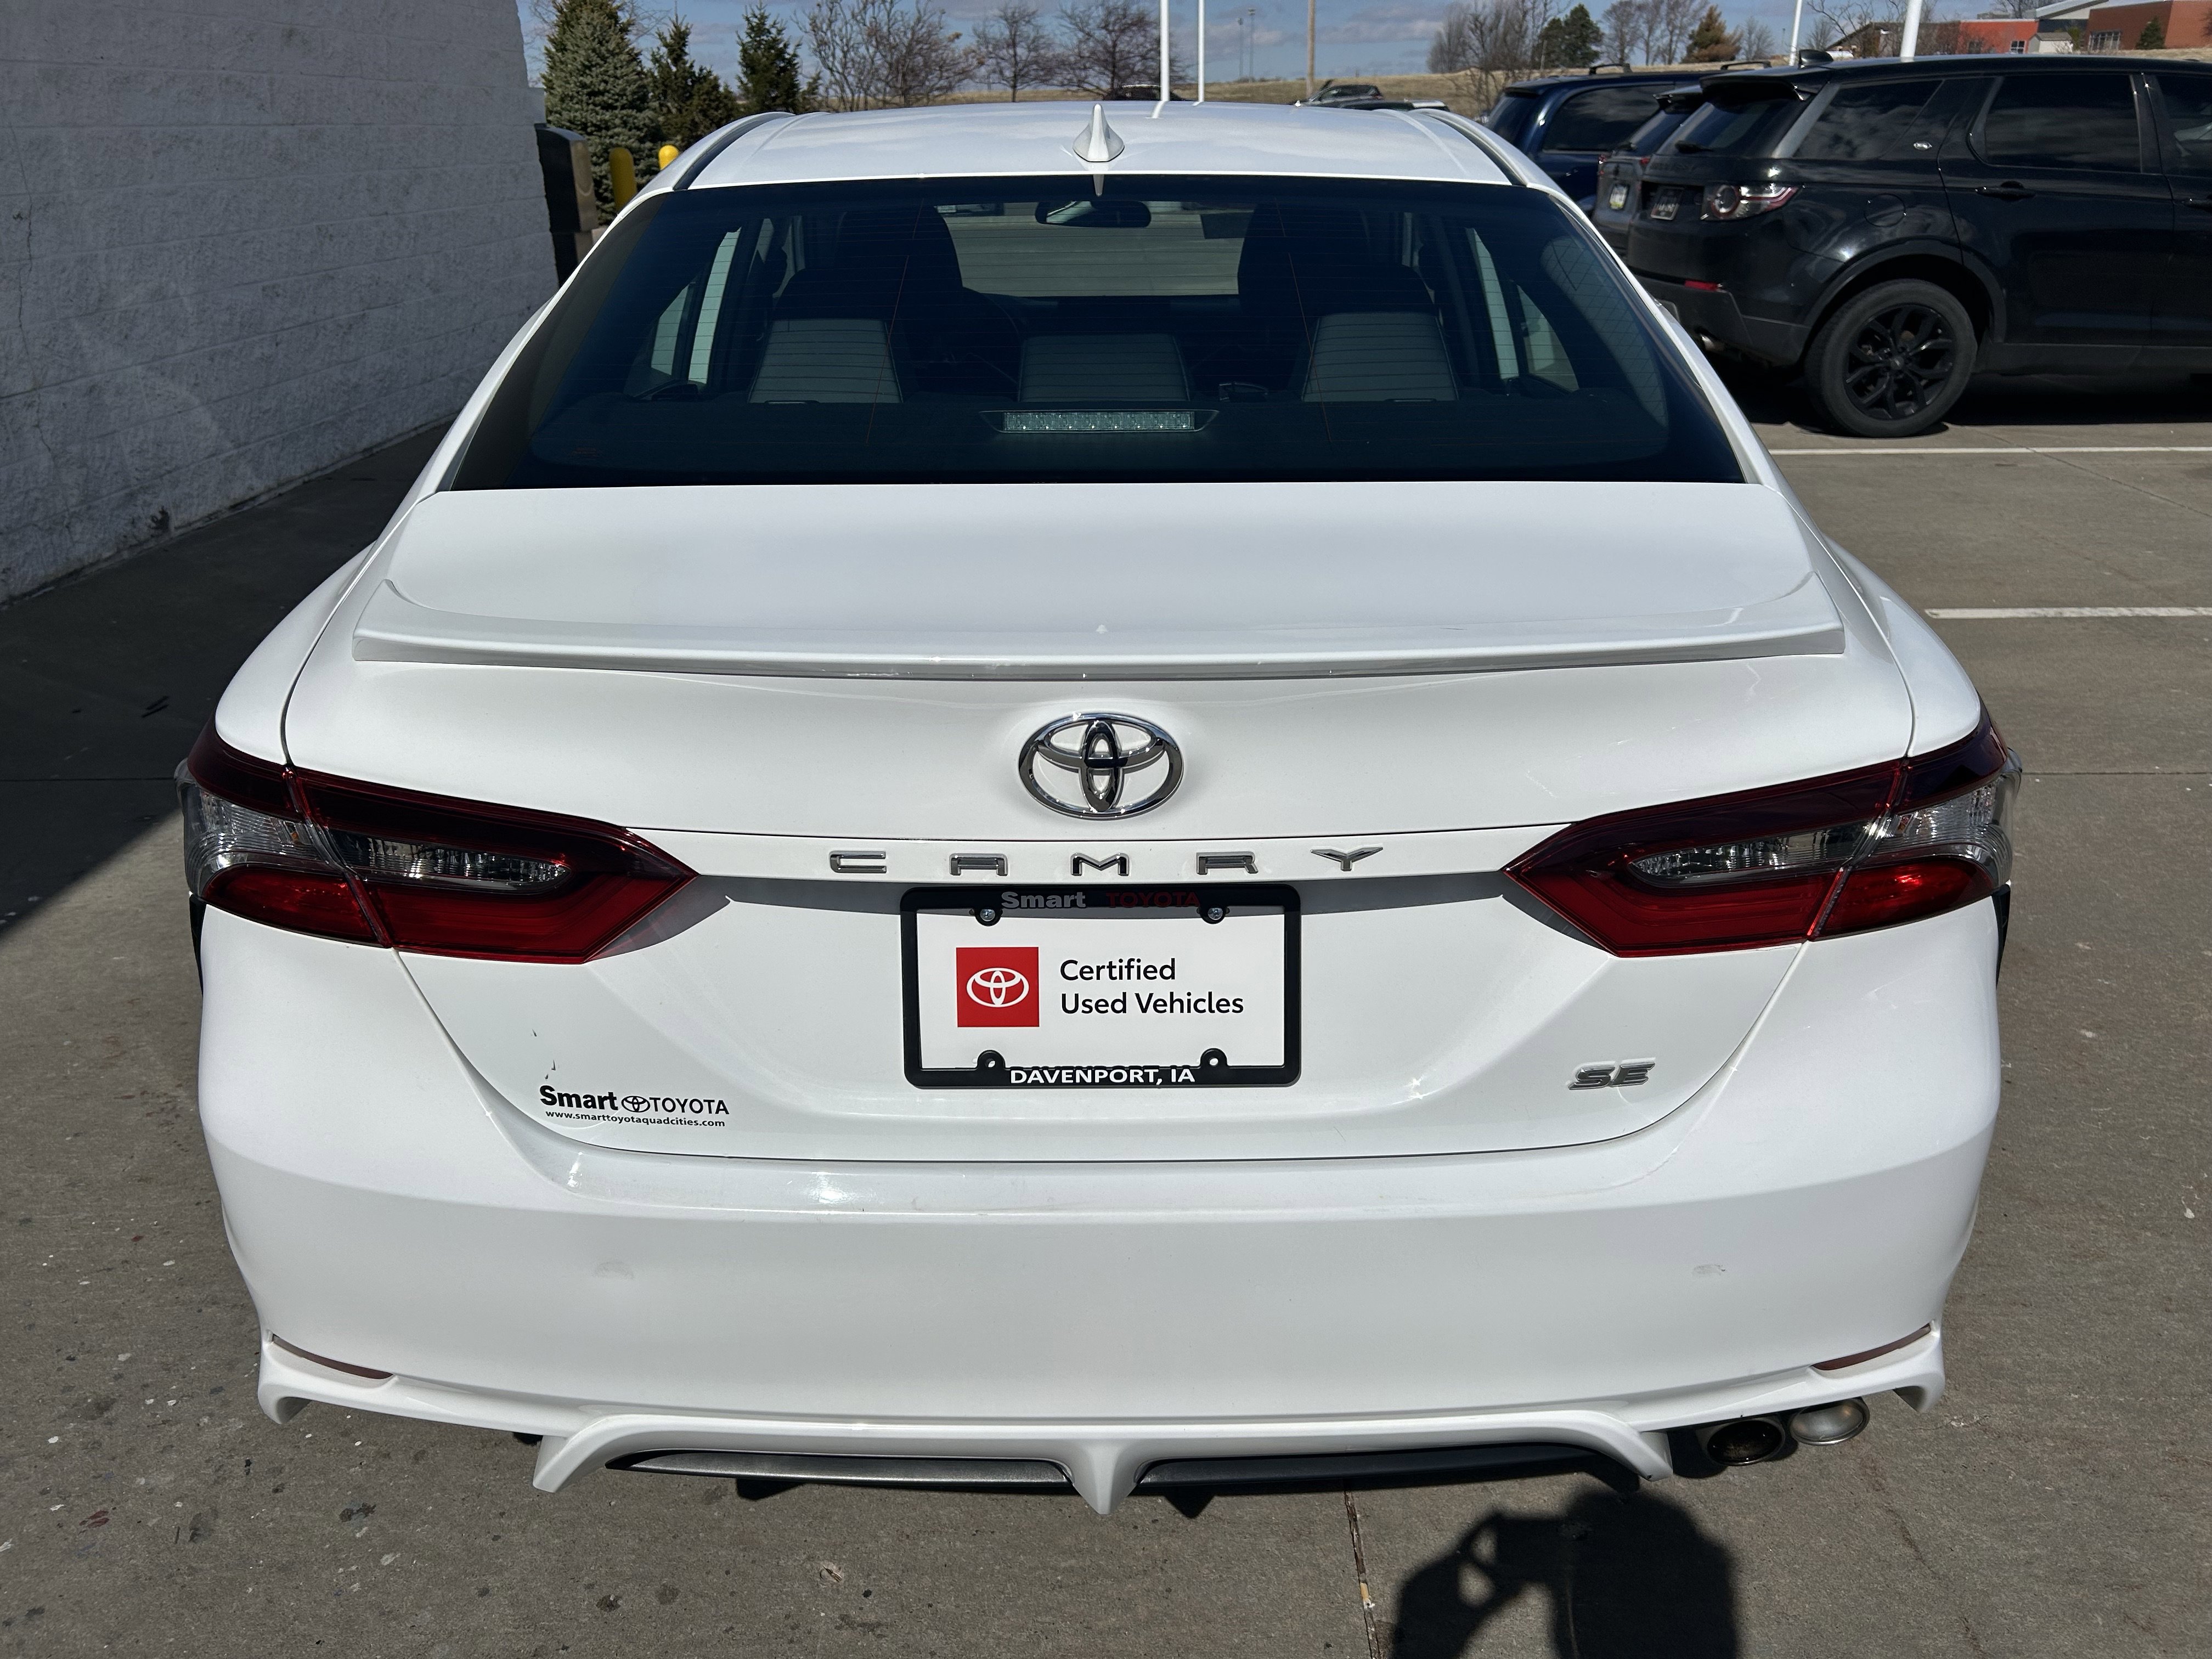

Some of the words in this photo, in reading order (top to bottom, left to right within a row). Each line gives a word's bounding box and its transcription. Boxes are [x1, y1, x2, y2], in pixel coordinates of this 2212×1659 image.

[829, 847, 1383, 876] CAMRY
[1001, 891, 1086, 909] Smart
[1106, 891, 1200, 907] TOYOTA
[1060, 957, 1176, 980] Certified
[1062, 991, 1127, 1014] Used
[1134, 991, 1244, 1014] Vehicles
[1010, 1069, 1163, 1085] DAVENPORT,
[1171, 1068, 1195, 1082] IA
[1567, 1060, 1656, 1090] SE
[539, 1085, 619, 1110] Smart
[649, 1097, 730, 1115] TOYOTA
[545, 1111, 725, 1127] www.smarttoyotaquadcities.com
